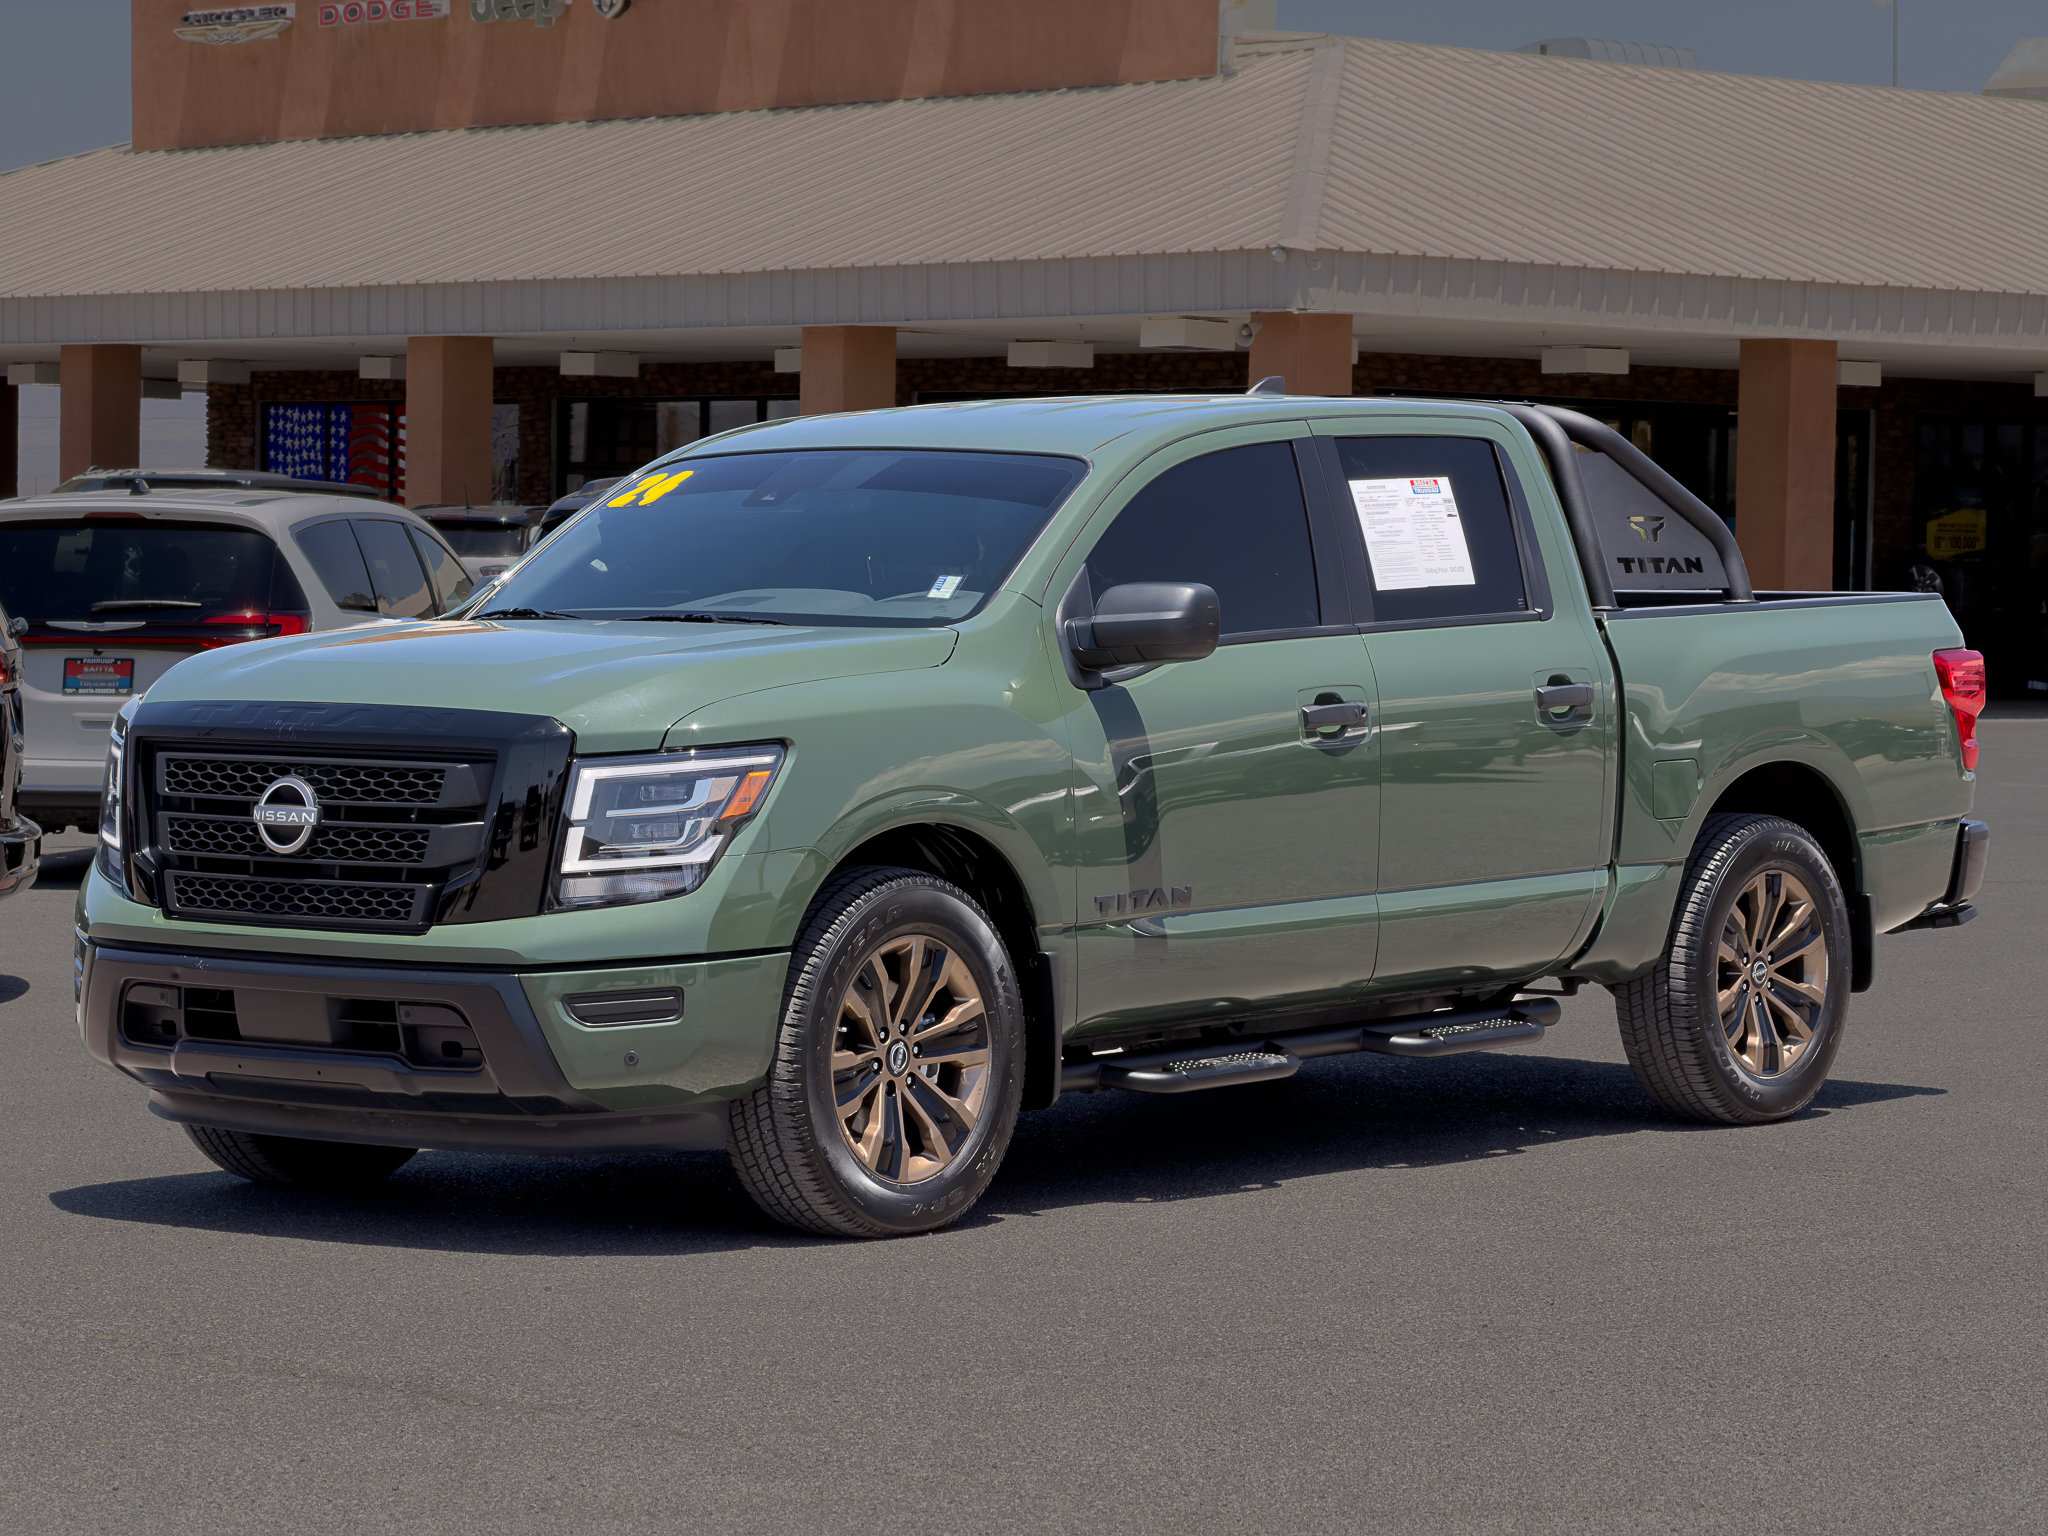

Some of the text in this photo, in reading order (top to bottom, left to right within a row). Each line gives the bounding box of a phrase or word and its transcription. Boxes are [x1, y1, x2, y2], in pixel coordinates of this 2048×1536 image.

[319, 0, 438, 26] DODGE
[606, 470, 694, 508] 24
[1616, 557, 1704, 574] TITAN
[189, 704, 461, 733] TITAN
[253, 808, 315, 825] NISSAN
[1094, 885, 1192, 915] TITAN
